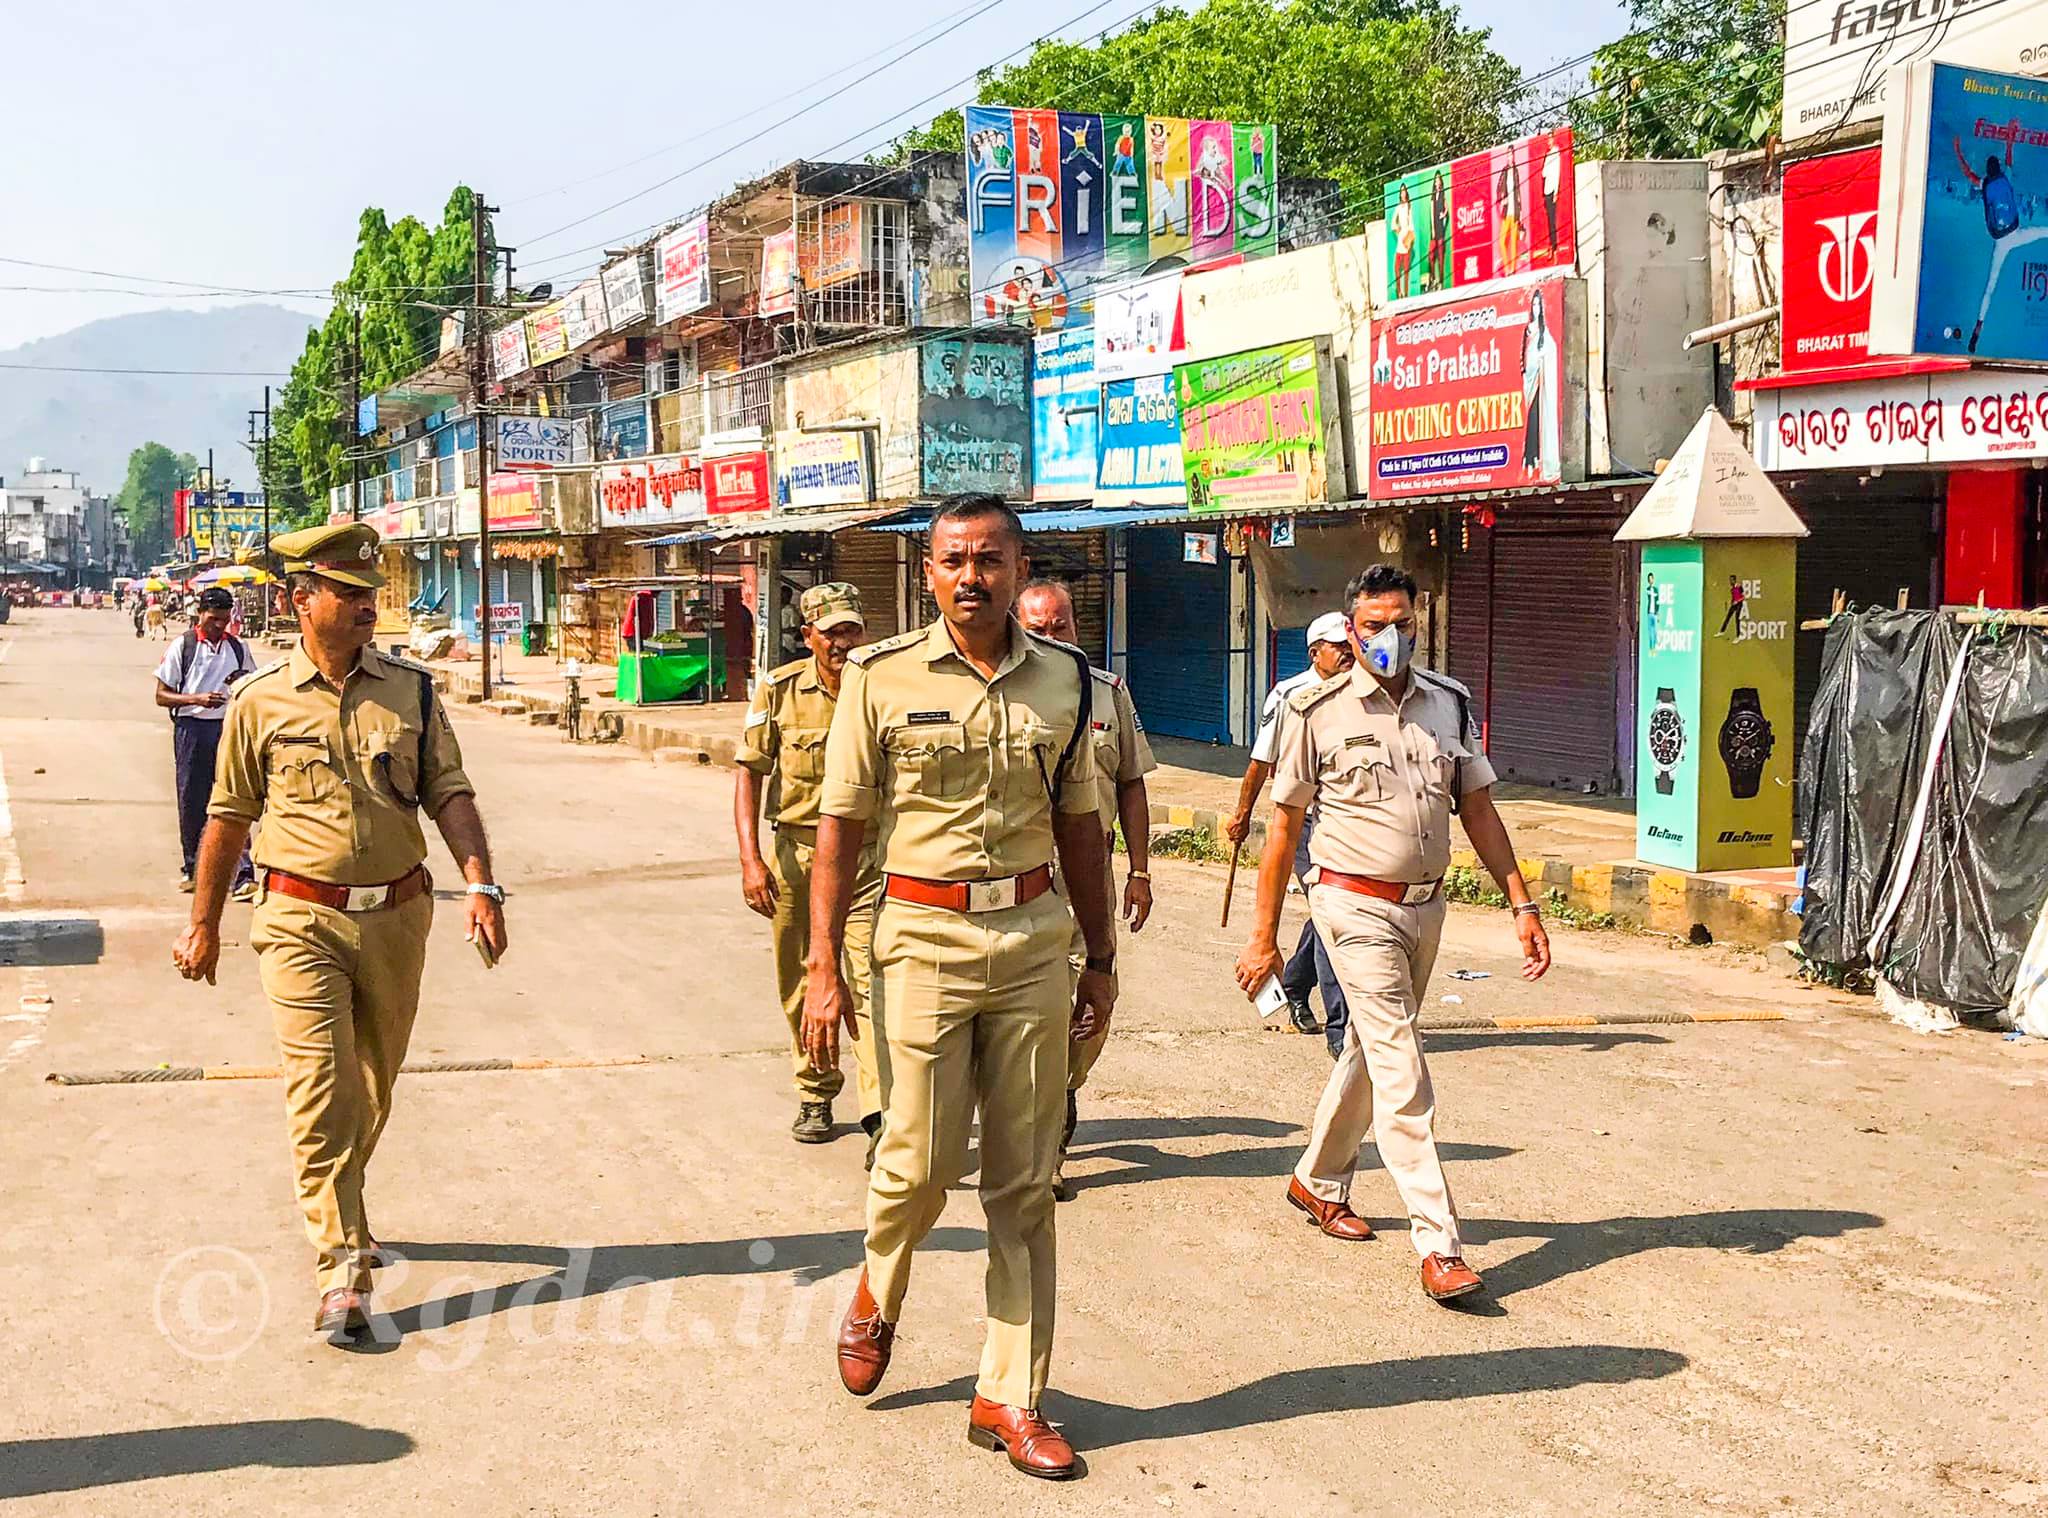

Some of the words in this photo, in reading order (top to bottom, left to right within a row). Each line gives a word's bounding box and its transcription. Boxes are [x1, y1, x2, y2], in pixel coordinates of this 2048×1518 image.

[1800, 98, 1847, 123] BHARAT
[1849, 90, 1876, 112] TIME
[1797, 334, 1845, 353] BHARAT
[1394, 354, 1423, 391] Sai
[1427, 337, 1501, 386] Prakash
[1372, 401, 1452, 447] MATCHING
[1455, 390, 1524, 434] CENTER
[1778, 407, 1850, 456] ଭାରତ
[1866, 397, 1945, 447] ଟାଇମ
[502, 447, 566, 462] SPORTS
[791, 463, 825, 490] FRIENDS
[824, 459, 861, 487] TAILORS
[1659, 583, 1674, 605] BE
[1742, 580, 1761, 598] BE
[1665, 607, 1674, 628] A
[1739, 601, 1750, 620] A
[1656, 630, 1694, 652] SPORT
[1739, 621, 1787, 641] SPORT
[1647, 825, 1684, 842] Octane
[1717, 830, 1775, 844] Octane
